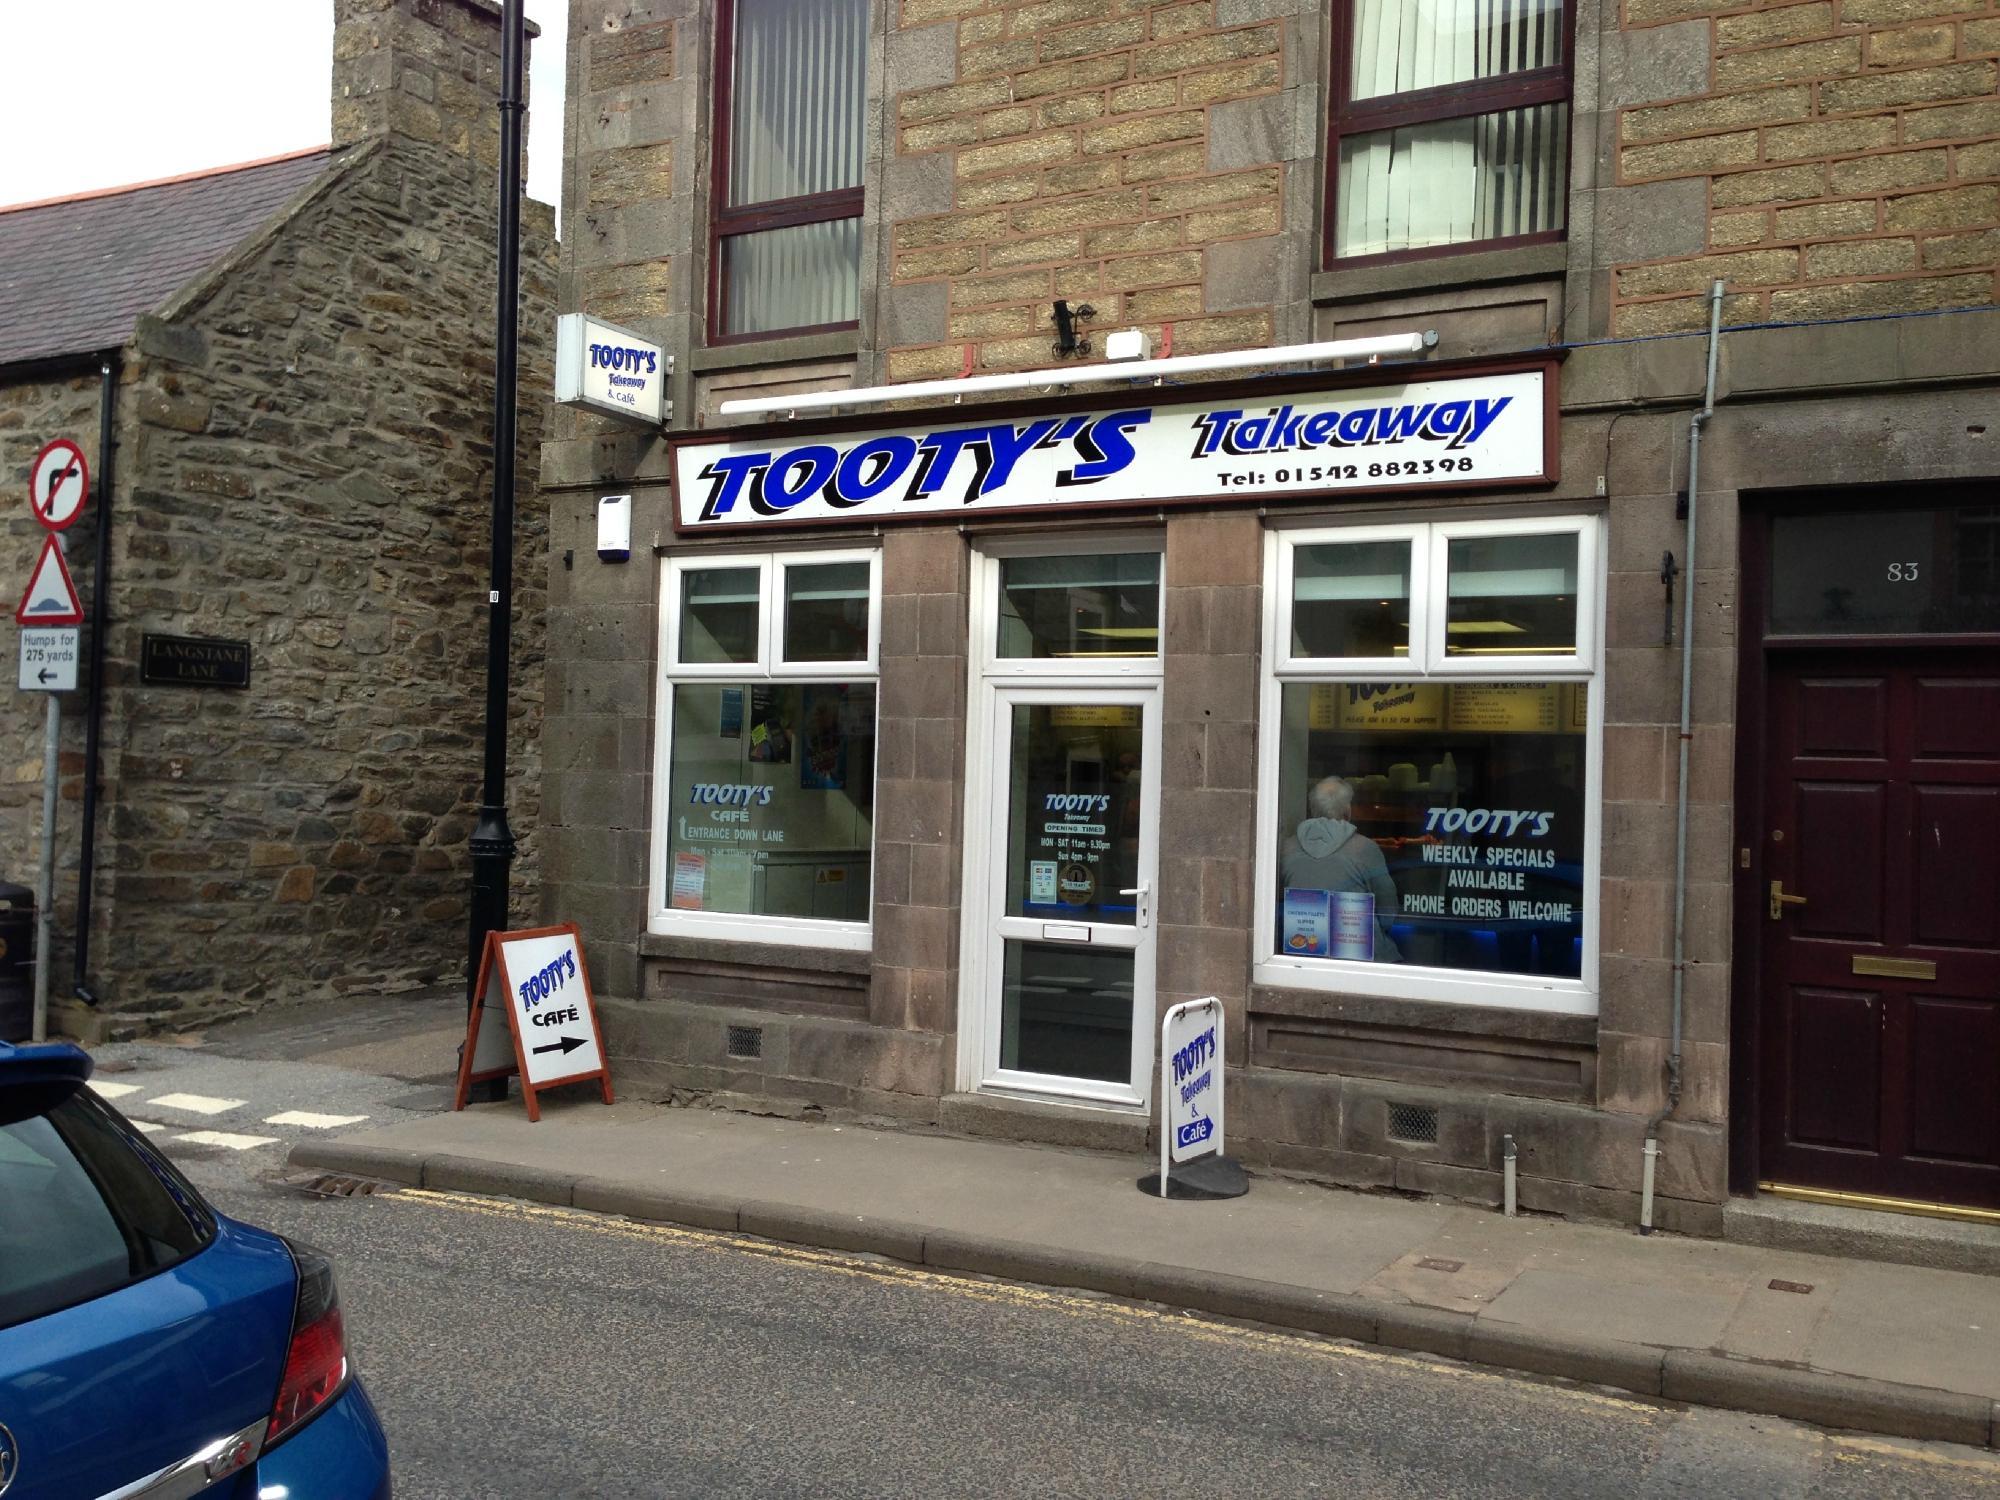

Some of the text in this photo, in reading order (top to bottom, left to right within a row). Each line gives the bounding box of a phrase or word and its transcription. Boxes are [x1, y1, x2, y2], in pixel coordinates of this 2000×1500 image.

[589, 343, 656, 374] TOOTY'S
[608, 373, 646, 390] Takeaway
[608, 389, 616, 399] &
[1191, 396, 1514, 459] Takeaway
[697, 409, 1152, 521] TOOTY'S
[1218, 457, 1474, 487] Tel: 01542 882398
[1887, 562, 1919, 581] 83
[24, 633, 75, 648] Humps for
[26, 649, 74, 664] 275 yards
[151, 642, 243, 663] LANGSTANE
[178, 662, 218, 678] LANE
[690, 783, 774, 806] TOOTY'S
[1044, 794, 1110, 812] TOOTY'S
[710, 808, 750, 823] CAFÉ
[1424, 807, 1555, 837] TOOTY'S
[687, 826, 784, 842] ENTRANCE DOWN LANE
[1040, 838, 1054, 847] MON
[1057, 838, 1069, 848] SAT
[1071, 839, 1087, 849] 11am
[1057, 851, 1069, 860] Sun
[1422, 844, 1556, 868] WEEKLY SPECIALS
[1447, 869, 1525, 891] AVAILABLE
[1403, 894, 1573, 922] PHONE ORDERS WELCOME
[519, 949, 576, 1012] TOOTY'S
[532, 1003, 580, 1028] CAFÉ
[1172, 1025, 1216, 1085] TOOTY'S
[1181, 1069, 1212, 1107] Takeaway
[1191, 1104, 1200, 1118] &
[1181, 1118, 1207, 1144] Café
